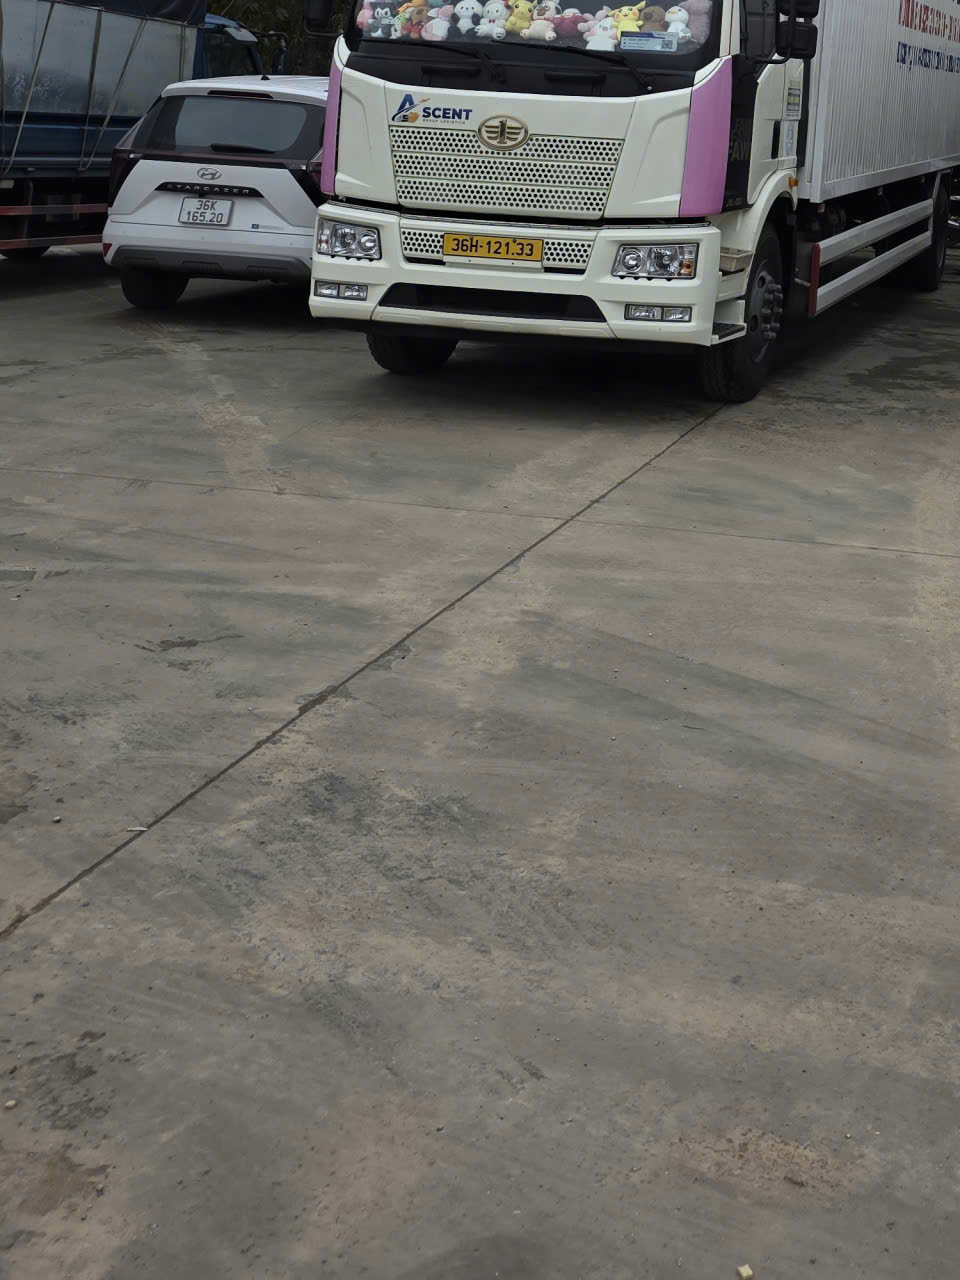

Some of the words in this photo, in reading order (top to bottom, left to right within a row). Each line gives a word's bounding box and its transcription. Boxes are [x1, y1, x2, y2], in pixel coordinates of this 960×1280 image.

[167, 184, 249, 195] STARGAZER
[196, 200, 218, 211] 36K
[186, 211, 224, 223] 165.20
[451, 238, 534, 257] 36H-121.33
